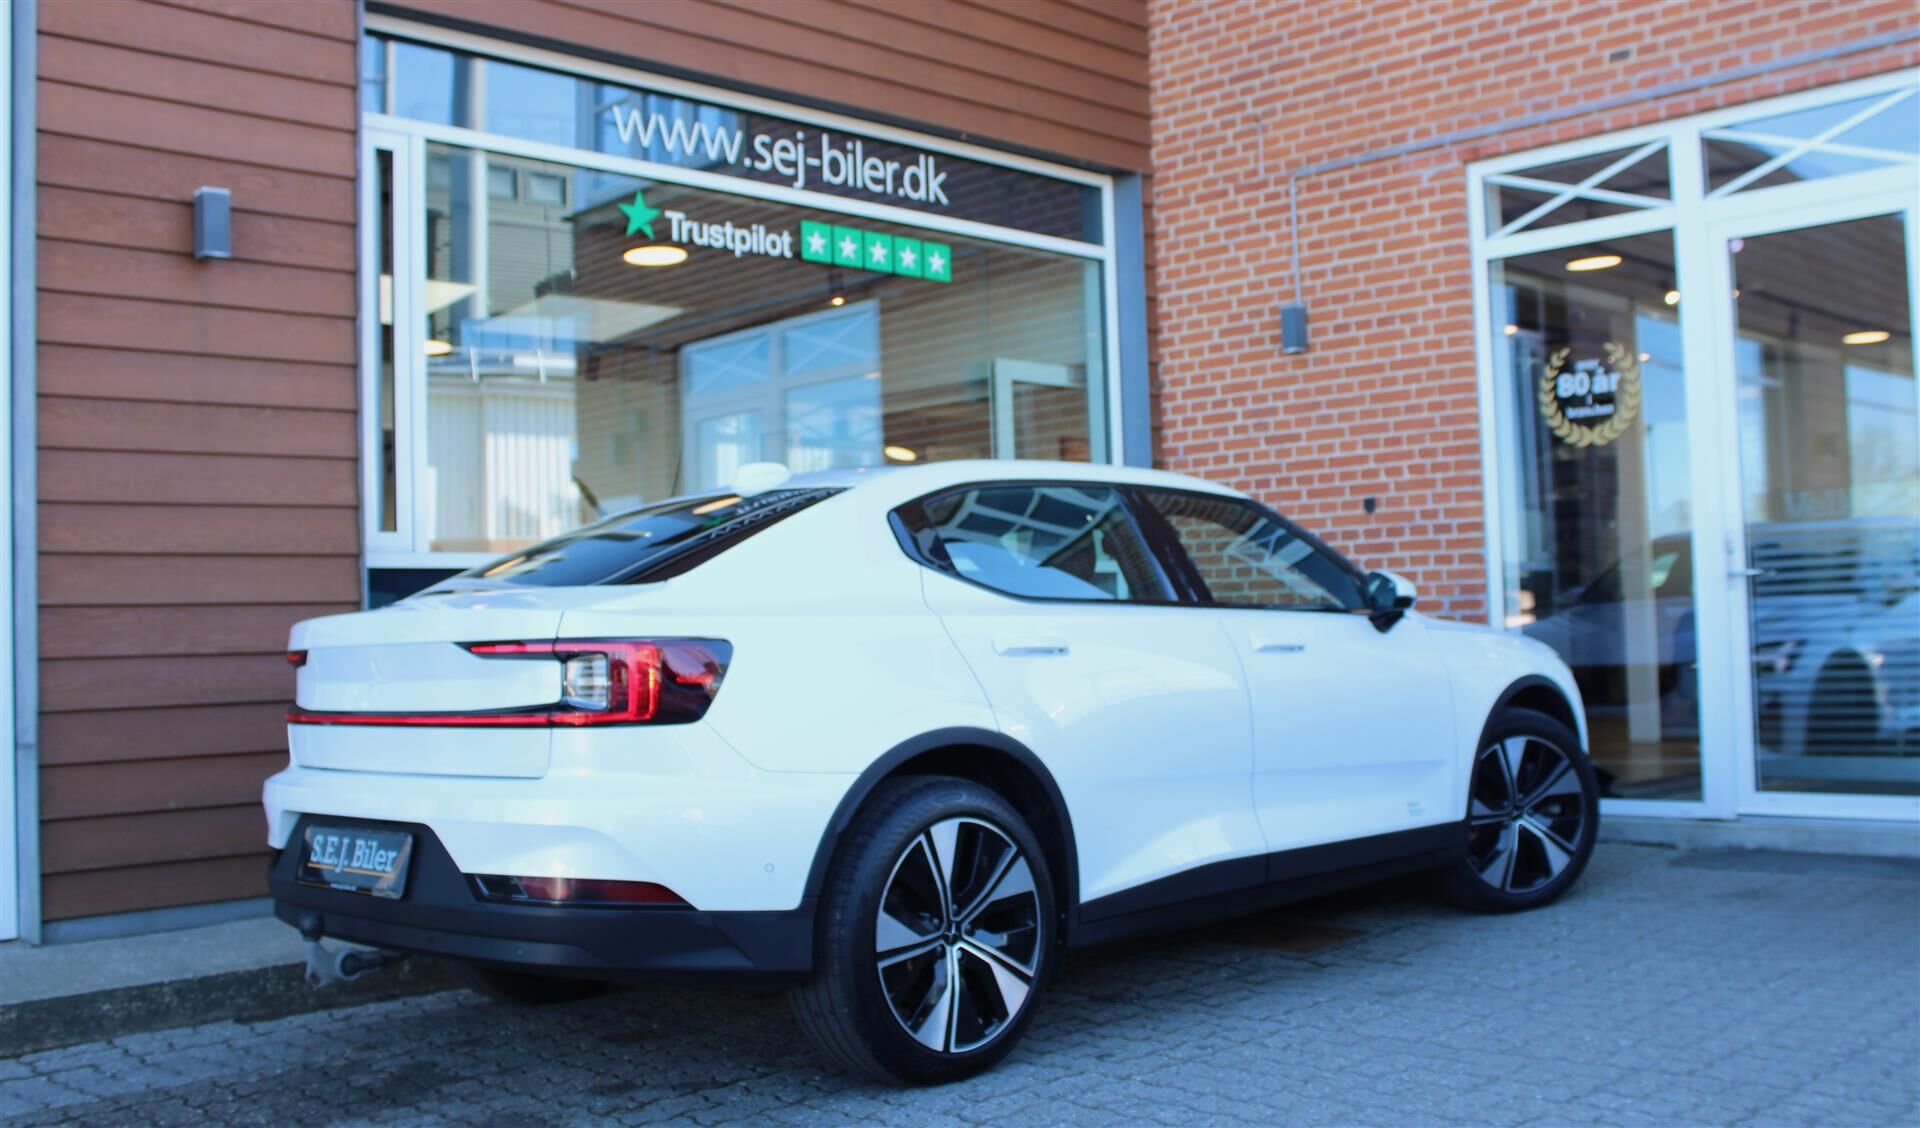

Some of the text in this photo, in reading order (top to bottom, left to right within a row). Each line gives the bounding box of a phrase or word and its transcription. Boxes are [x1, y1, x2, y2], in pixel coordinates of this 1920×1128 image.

[612, 104, 949, 205] www.sej-biler.dk
[664, 210, 793, 259] Trustpilot
[1556, 372, 1590, 398] 80
[350, 839, 397, 872] Biler
